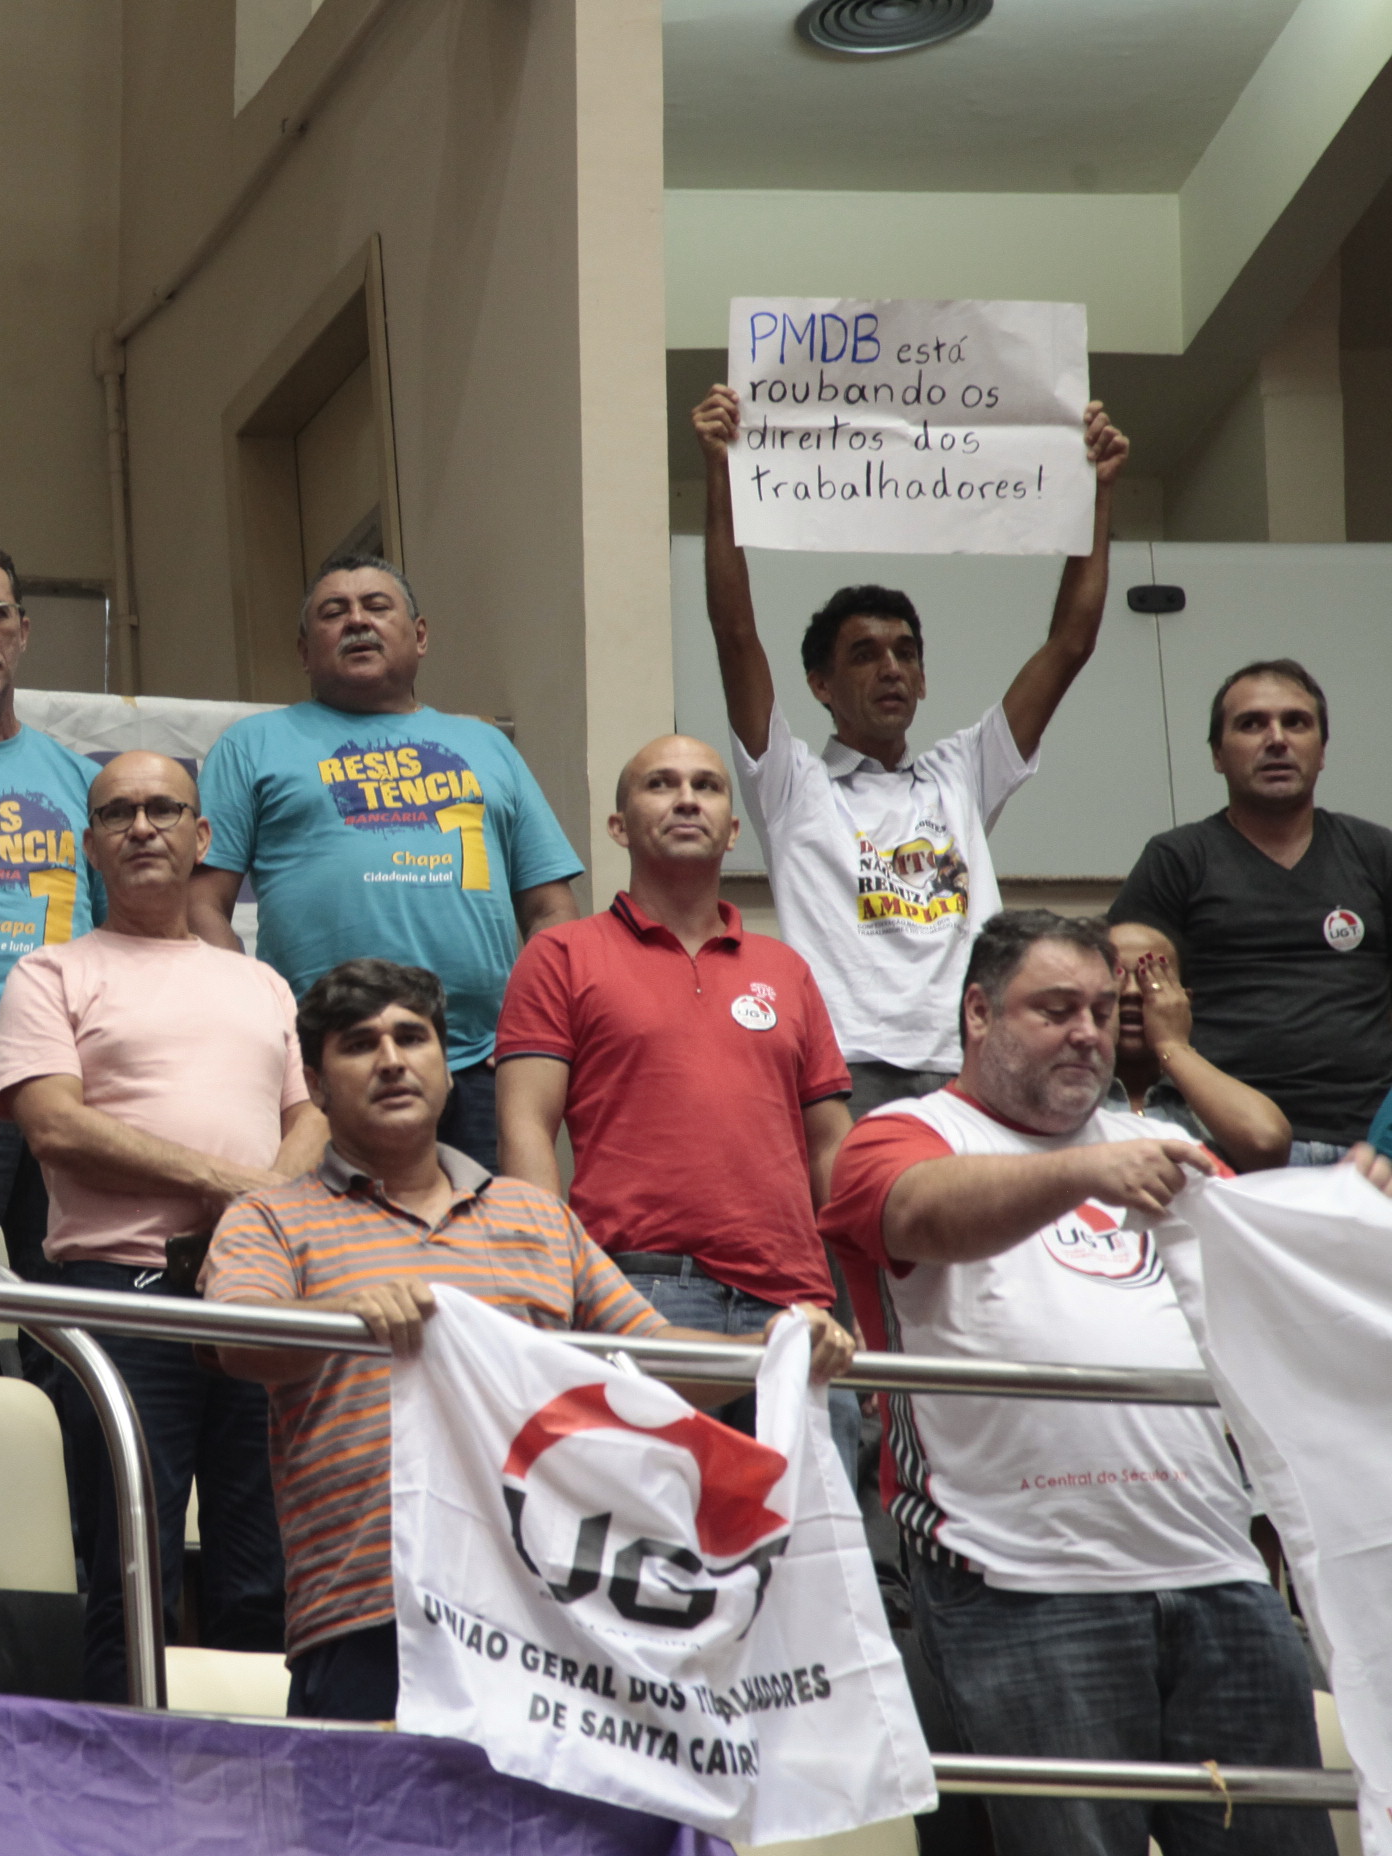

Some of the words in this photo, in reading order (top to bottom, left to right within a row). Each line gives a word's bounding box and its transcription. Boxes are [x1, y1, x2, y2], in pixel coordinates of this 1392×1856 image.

[750, 312, 881, 364] PMDB
[896, 335, 968, 364] está
[750, 369, 946, 406] roubando
[961, 384, 1000, 408] os
[747, 414, 884, 451] direitos
[914, 420, 980, 454] dos
[751, 460, 1043, 502] trabalhadores!
[317, 748, 422, 785] RESIS
[358, 769, 483, 810] TÊNCIA
[344, 811, 429, 825] BANCÁRIA
[391, 851, 453, 870] Chapa
[435, 802, 491, 891] 1
[363, 871, 418, 882] Cidadania
[420, 874, 426, 882] e
[29, 868, 78, 947] 1
[0, 942, 7, 951] e
[1329, 925, 1358, 939] UGT
[1020, 1478, 1030, 1491] A
[1035, 1470, 1091, 1489] Central
[1097, 1469, 1117, 1484] do
[1122, 1467, 1169, 1483] Século
[424, 1593, 508, 1660] UNIÃO
[521, 1643, 617, 1700] GERAL
[629, 1675, 687, 1712] DOS
[529, 1693, 568, 1729] DE
[580, 1710, 678, 1766] SANTA
